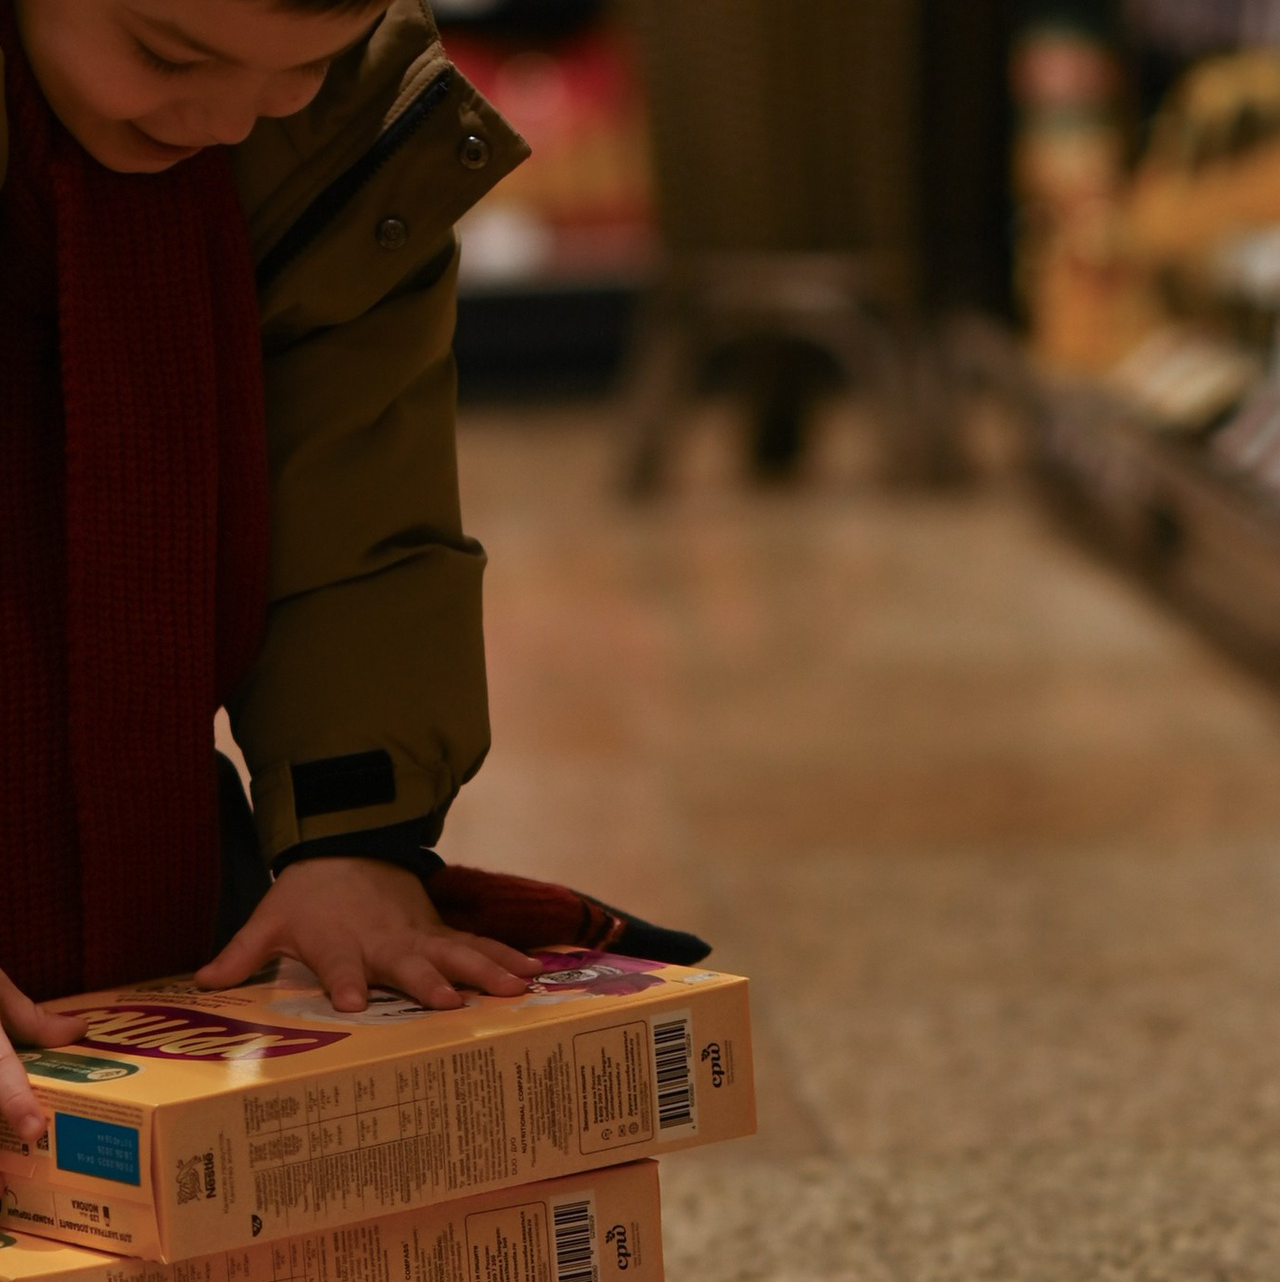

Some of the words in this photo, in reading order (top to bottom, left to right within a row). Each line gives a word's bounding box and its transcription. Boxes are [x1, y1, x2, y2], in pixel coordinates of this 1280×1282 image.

[72, 1010, 320, 1058] ХРУТК
[706, 1040, 725, 1090] cpw
[518, 1103, 527, 1154] NUTRITIONAL
[202, 1151, 216, 1199] Nestlé
[71, 1198, 98, 1215] МОЛОКА
[89, 1224, 118, 1241] ЗАВТРАКА
[611, 1222, 632, 1272] cpw
[472, 1244, 480, 1274] пишите
